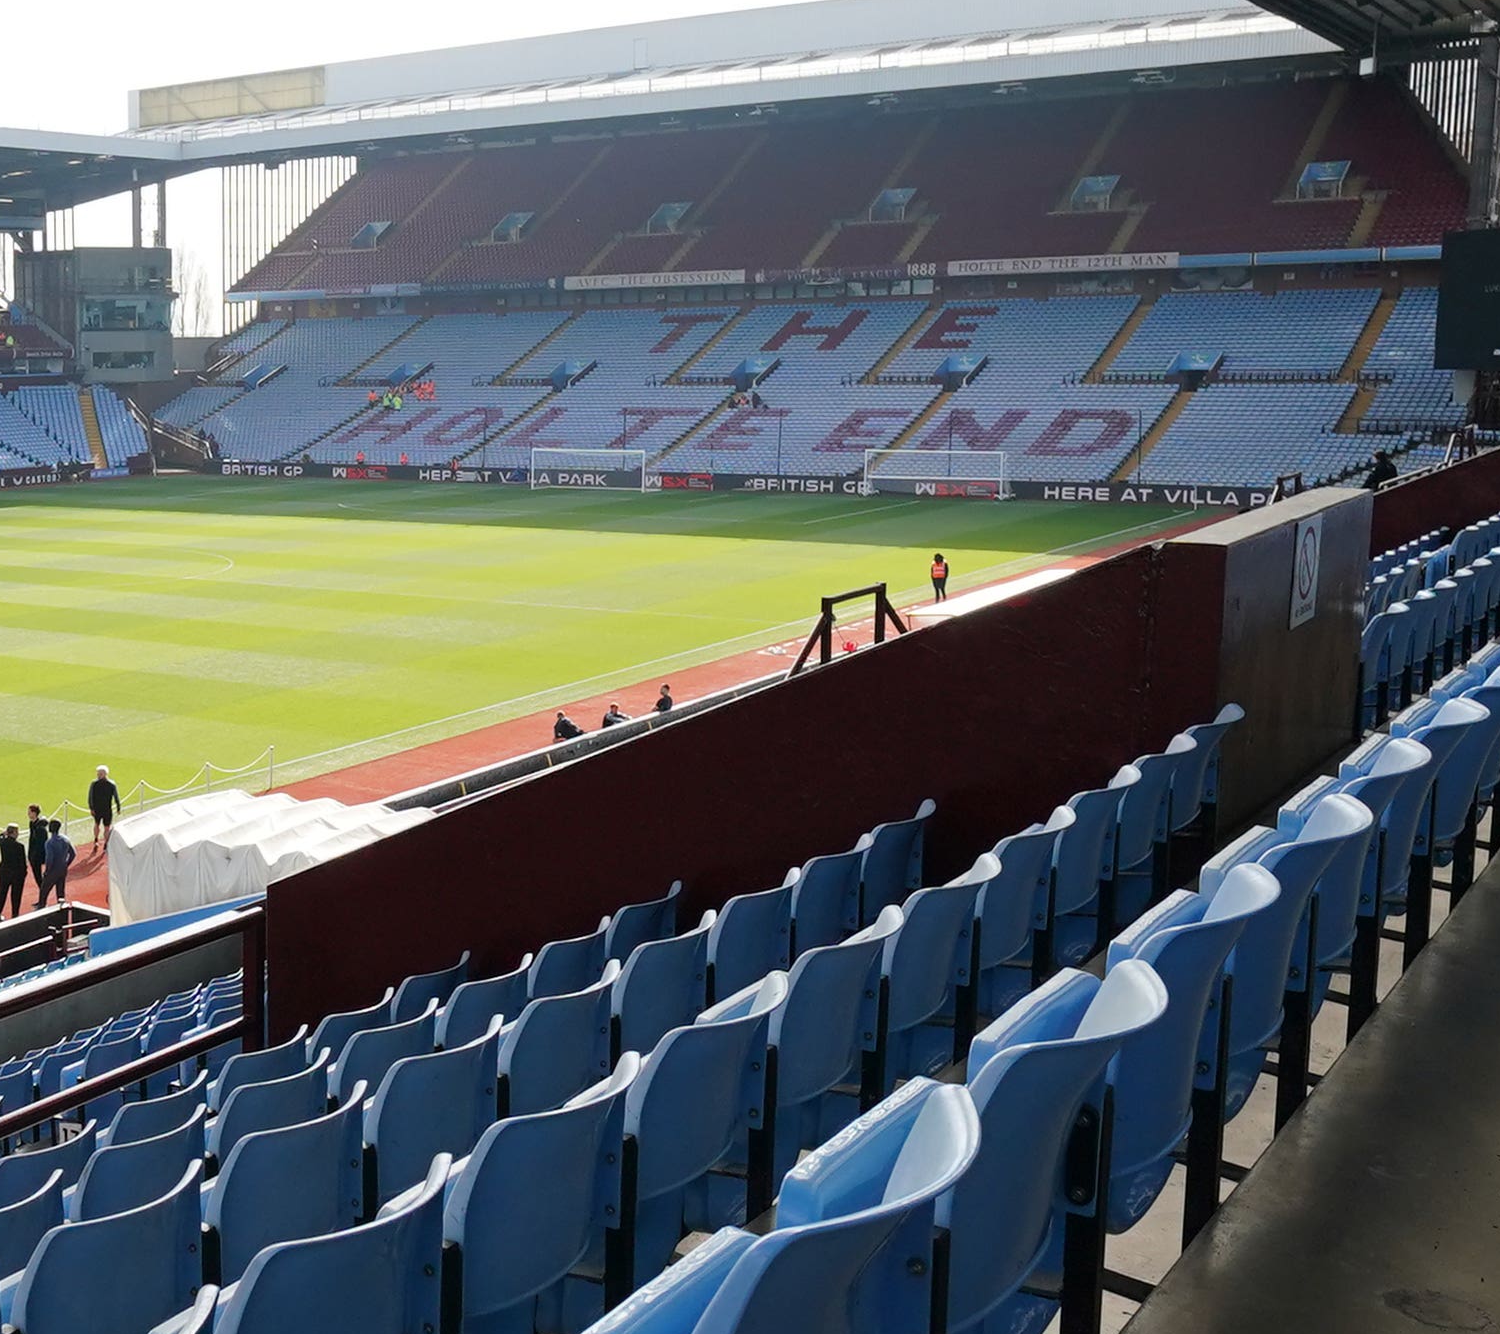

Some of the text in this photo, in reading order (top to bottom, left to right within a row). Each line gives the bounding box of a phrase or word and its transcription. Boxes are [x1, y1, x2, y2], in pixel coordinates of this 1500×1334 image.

[907, 263, 937, 276] 1888
[1012, 259, 1042, 270] END
[1048, 257, 1080, 268] THE
[1130, 254, 1168, 266] MAN
[649, 307, 998, 353] THE
[812, 409, 1134, 455] END
[283, 466, 303, 476] GP
[558, 473, 607, 486] PARK
[754, 479, 834, 493] BRITISH
[1044, 486, 1110, 500] HERE
[1120, 488, 1152, 502] AT
[1163, 489, 1240, 505] VILLA
